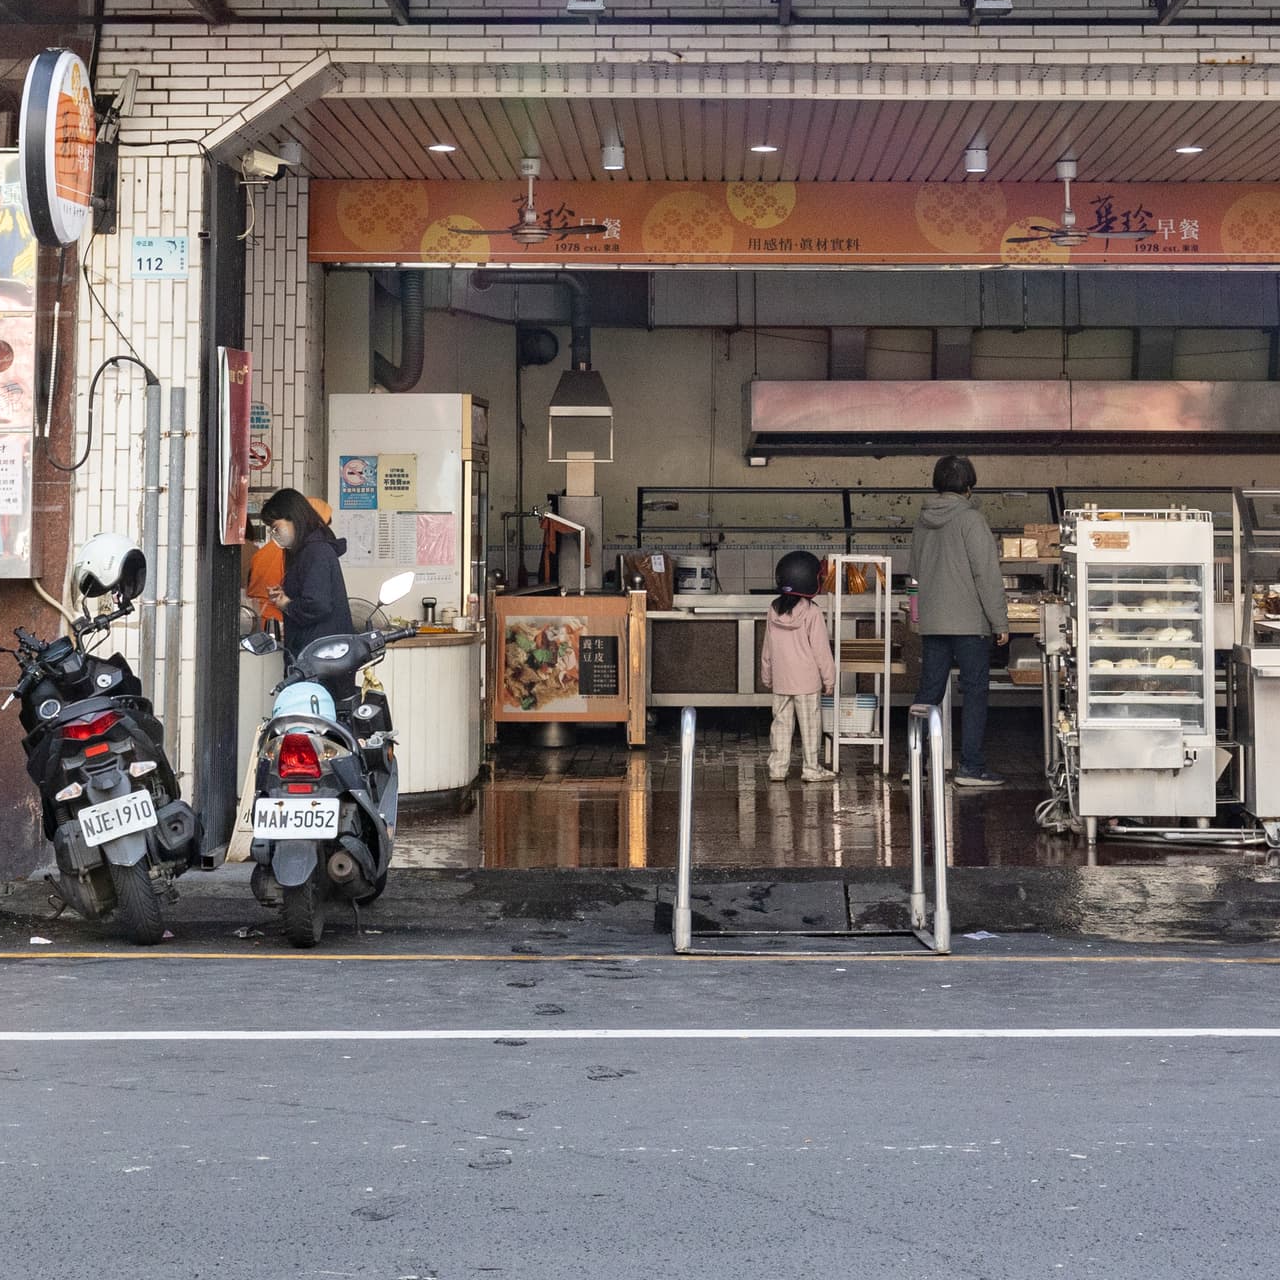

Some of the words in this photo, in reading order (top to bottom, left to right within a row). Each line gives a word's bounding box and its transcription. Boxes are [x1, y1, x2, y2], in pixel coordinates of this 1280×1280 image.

[555, 243, 579, 252] 1978
[1134, 244, 1159, 252] 1978
[136, 257, 163, 271] 112
[583, 652, 604, 662] 豆皮
